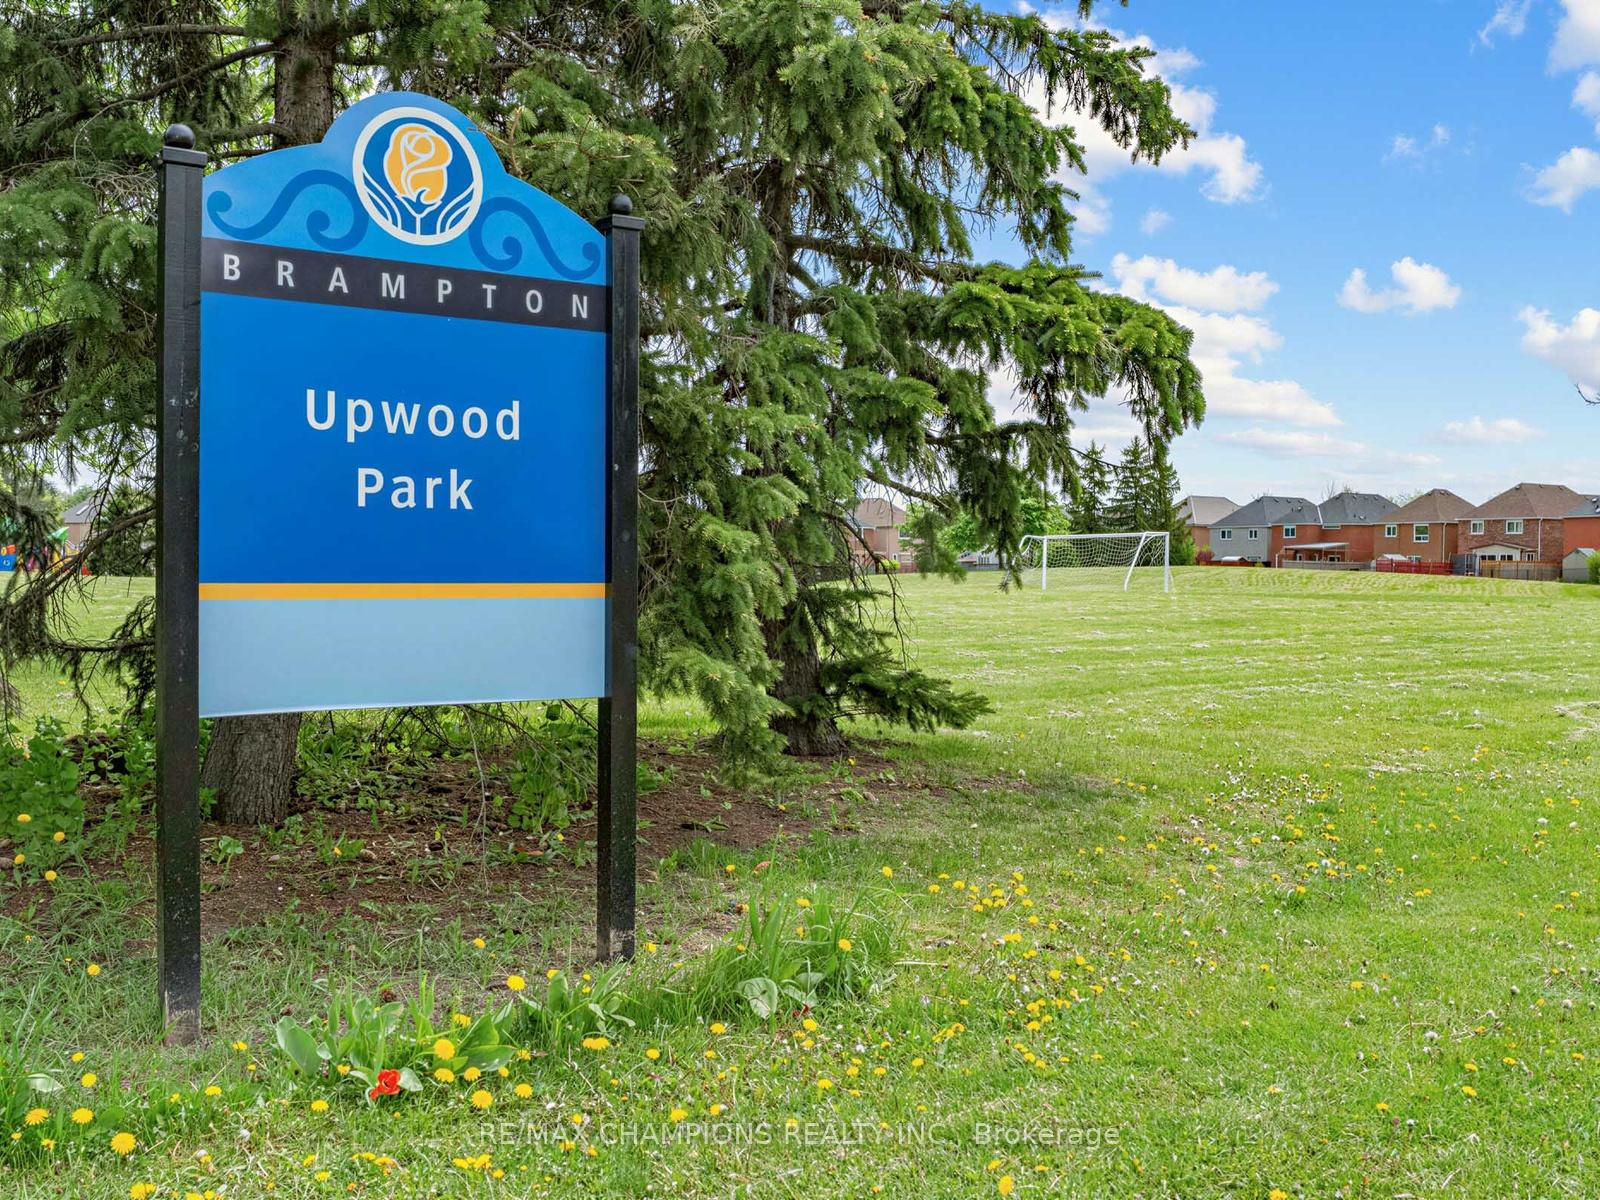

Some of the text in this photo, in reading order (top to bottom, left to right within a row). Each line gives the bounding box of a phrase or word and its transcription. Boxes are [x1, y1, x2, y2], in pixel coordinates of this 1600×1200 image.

[222, 253, 589, 319] BRAMPTON
[306, 388, 521, 443] Upwood
[357, 467, 474, 511] Park
